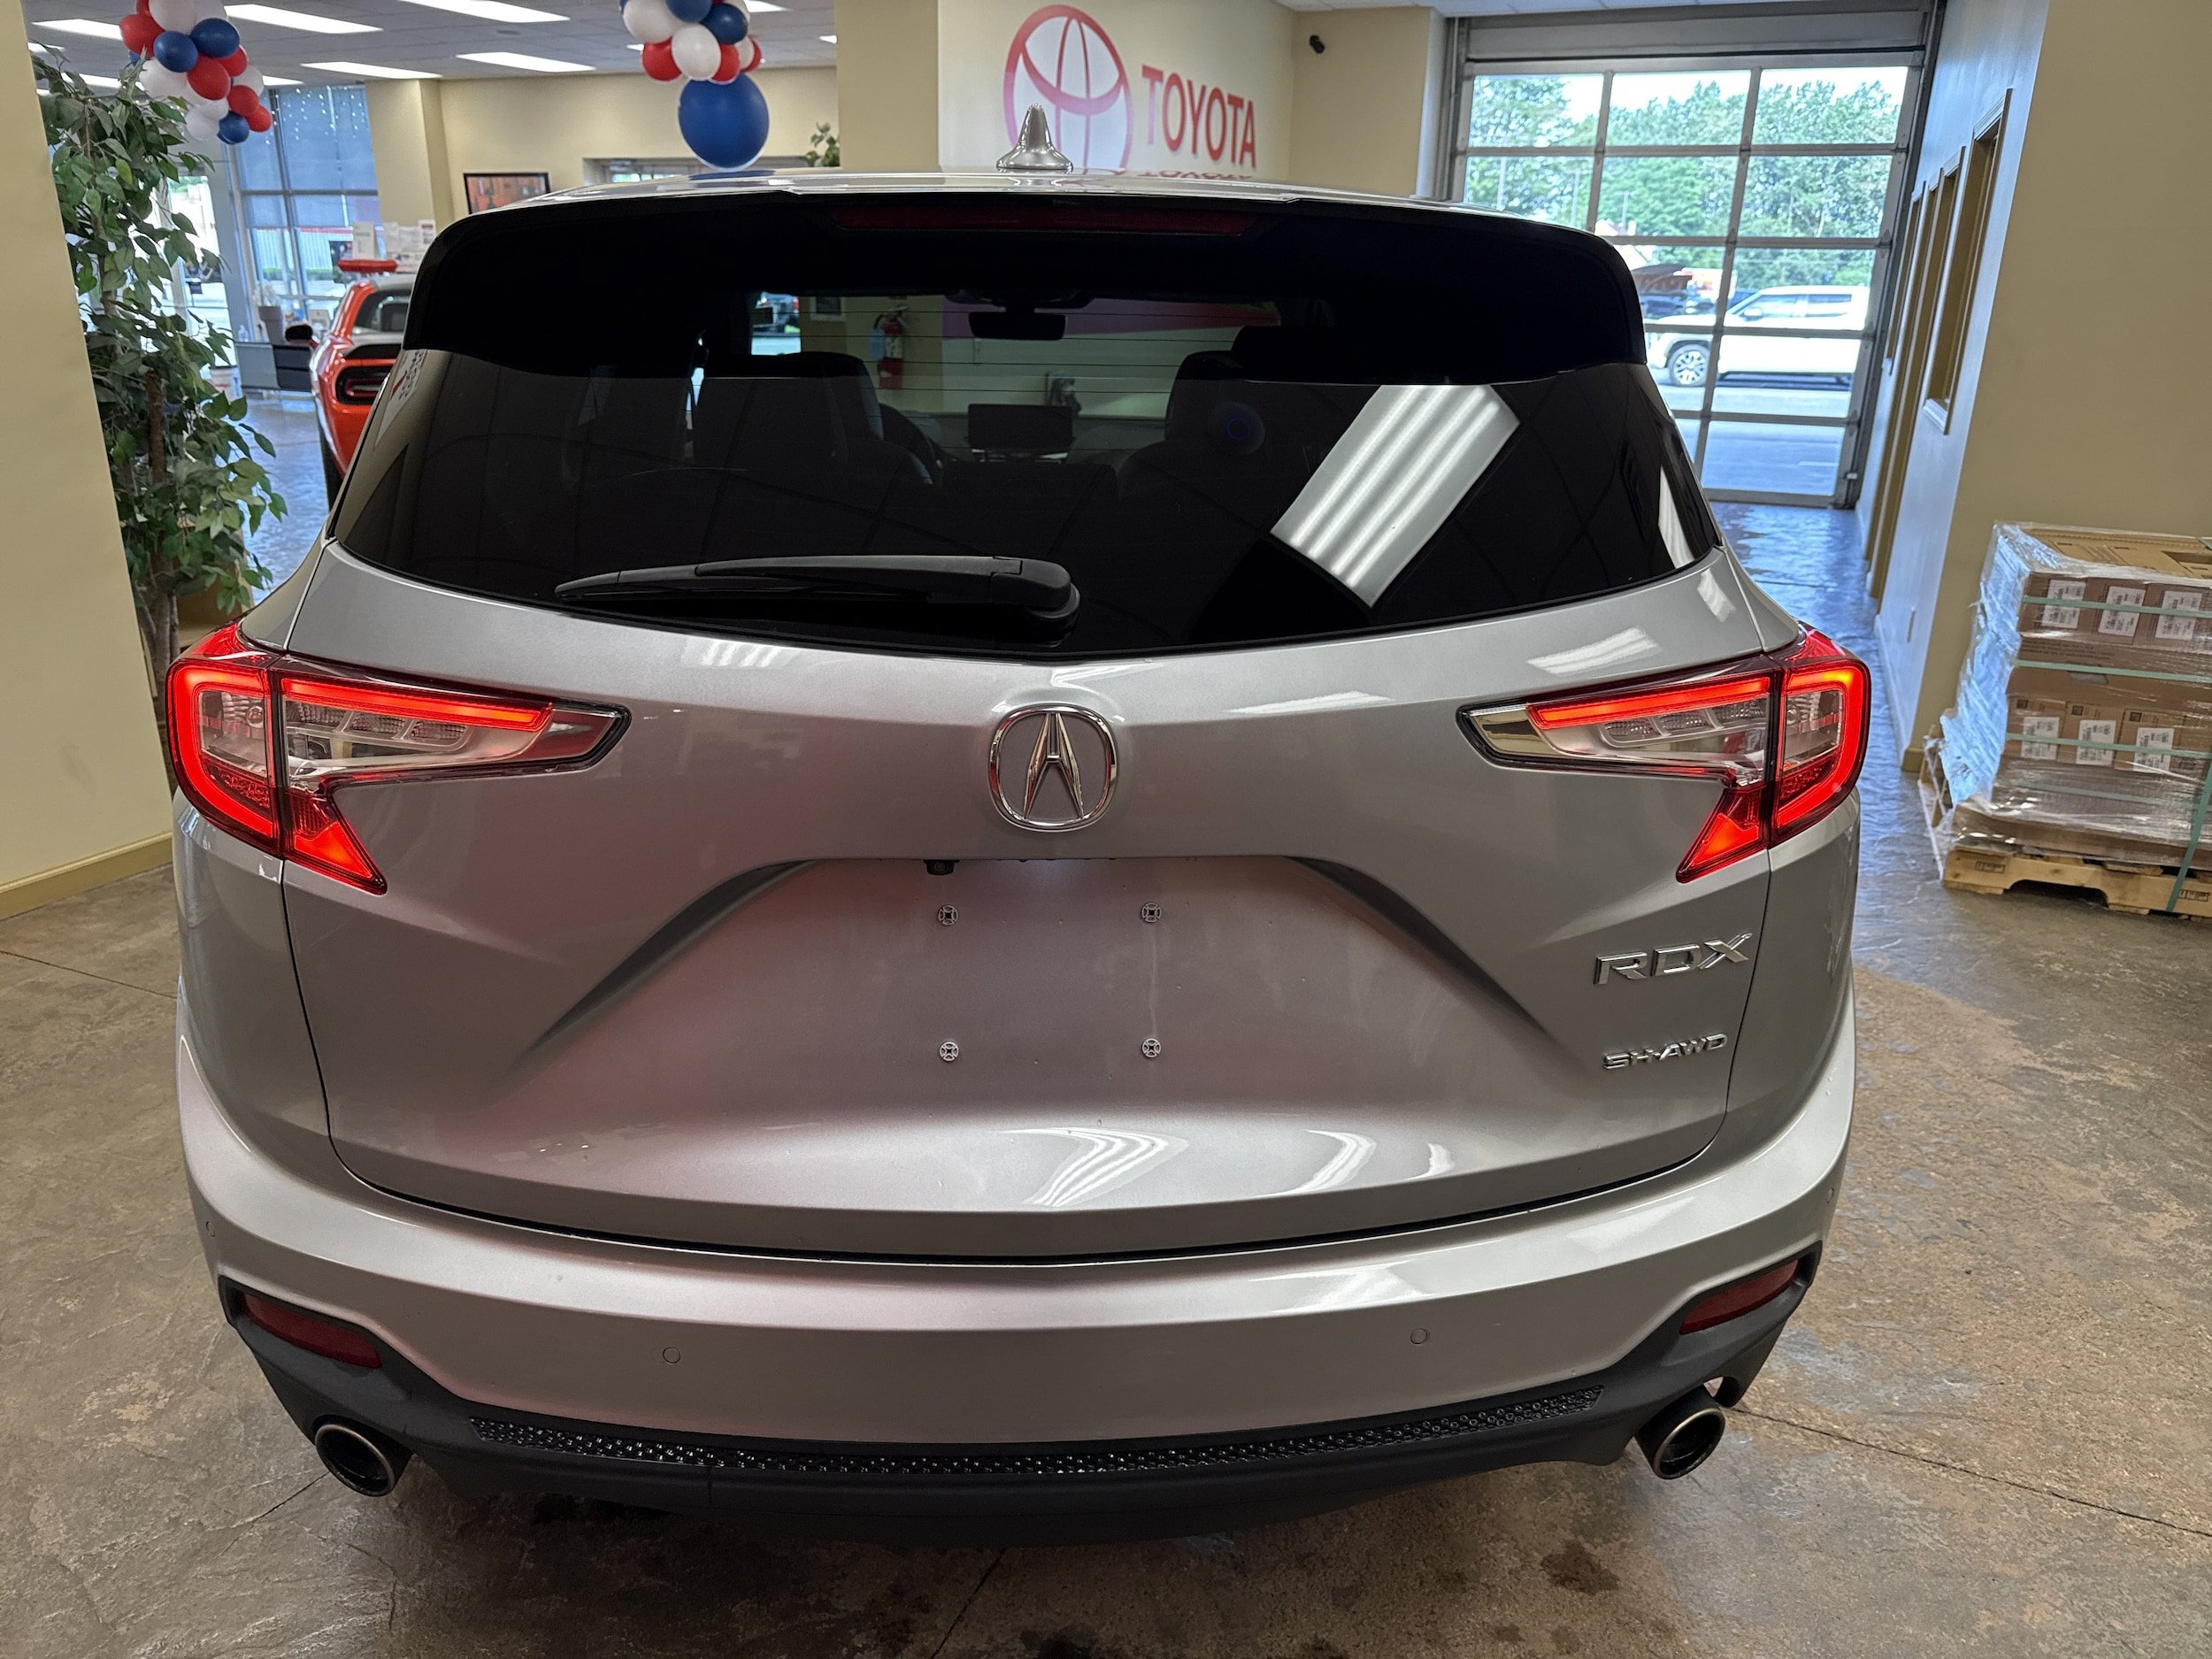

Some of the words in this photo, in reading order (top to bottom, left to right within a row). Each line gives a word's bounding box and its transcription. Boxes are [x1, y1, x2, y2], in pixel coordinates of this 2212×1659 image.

[1141, 65, 1256, 168] TOYOTA
[1594, 933, 1753, 984] RDX
[1603, 1033, 1727, 1069] SH-AWD
